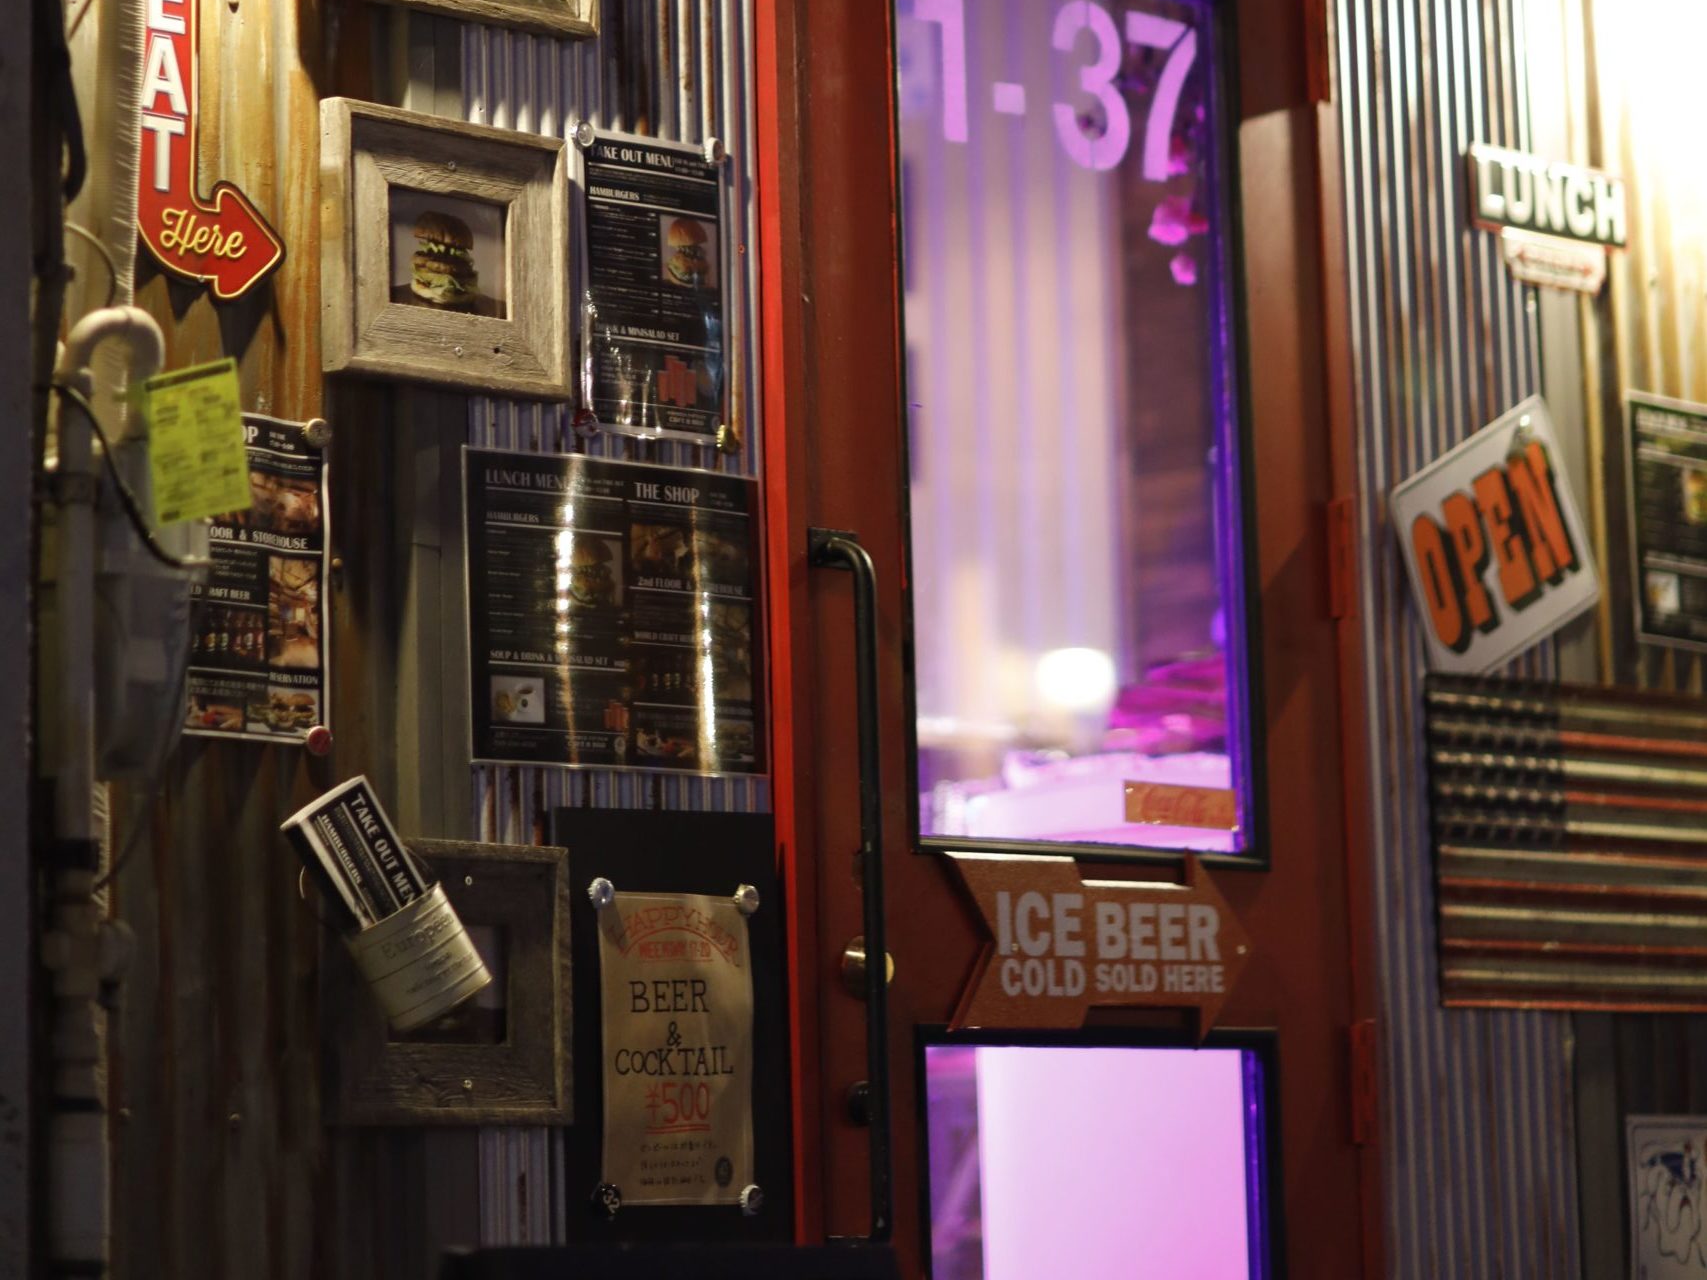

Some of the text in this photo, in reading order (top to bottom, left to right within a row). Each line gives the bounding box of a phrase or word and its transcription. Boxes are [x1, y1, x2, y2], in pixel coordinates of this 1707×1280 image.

[620, 148, 644, 162] OUT
[645, 152, 675, 168] MENU
[589, 185, 640, 201] HAMBURGERS
[1478, 150, 1627, 243] LUNCH
[159, 207, 248, 259] Here
[485, 468, 531, 488] LUNCH
[633, 481, 661, 500] THE
[664, 484, 701, 504] SHOP
[239, 529, 247, 541] &
[1411, 441, 1579, 651] OPEN
[319, 814, 363, 884] HAMBURGERS
[350, 792, 376, 838] TAKE
[374, 837, 399, 871] OUT
[996, 891, 1221, 962] ICE BEER
[628, 979, 710, 1014] BEER
[1000, 958, 1226, 998] COLD SOLD HERE
[665, 1021, 682, 1049] &
[614, 1045, 734, 1077] COCKTAIL
[644, 1081, 710, 1125] ¥500
